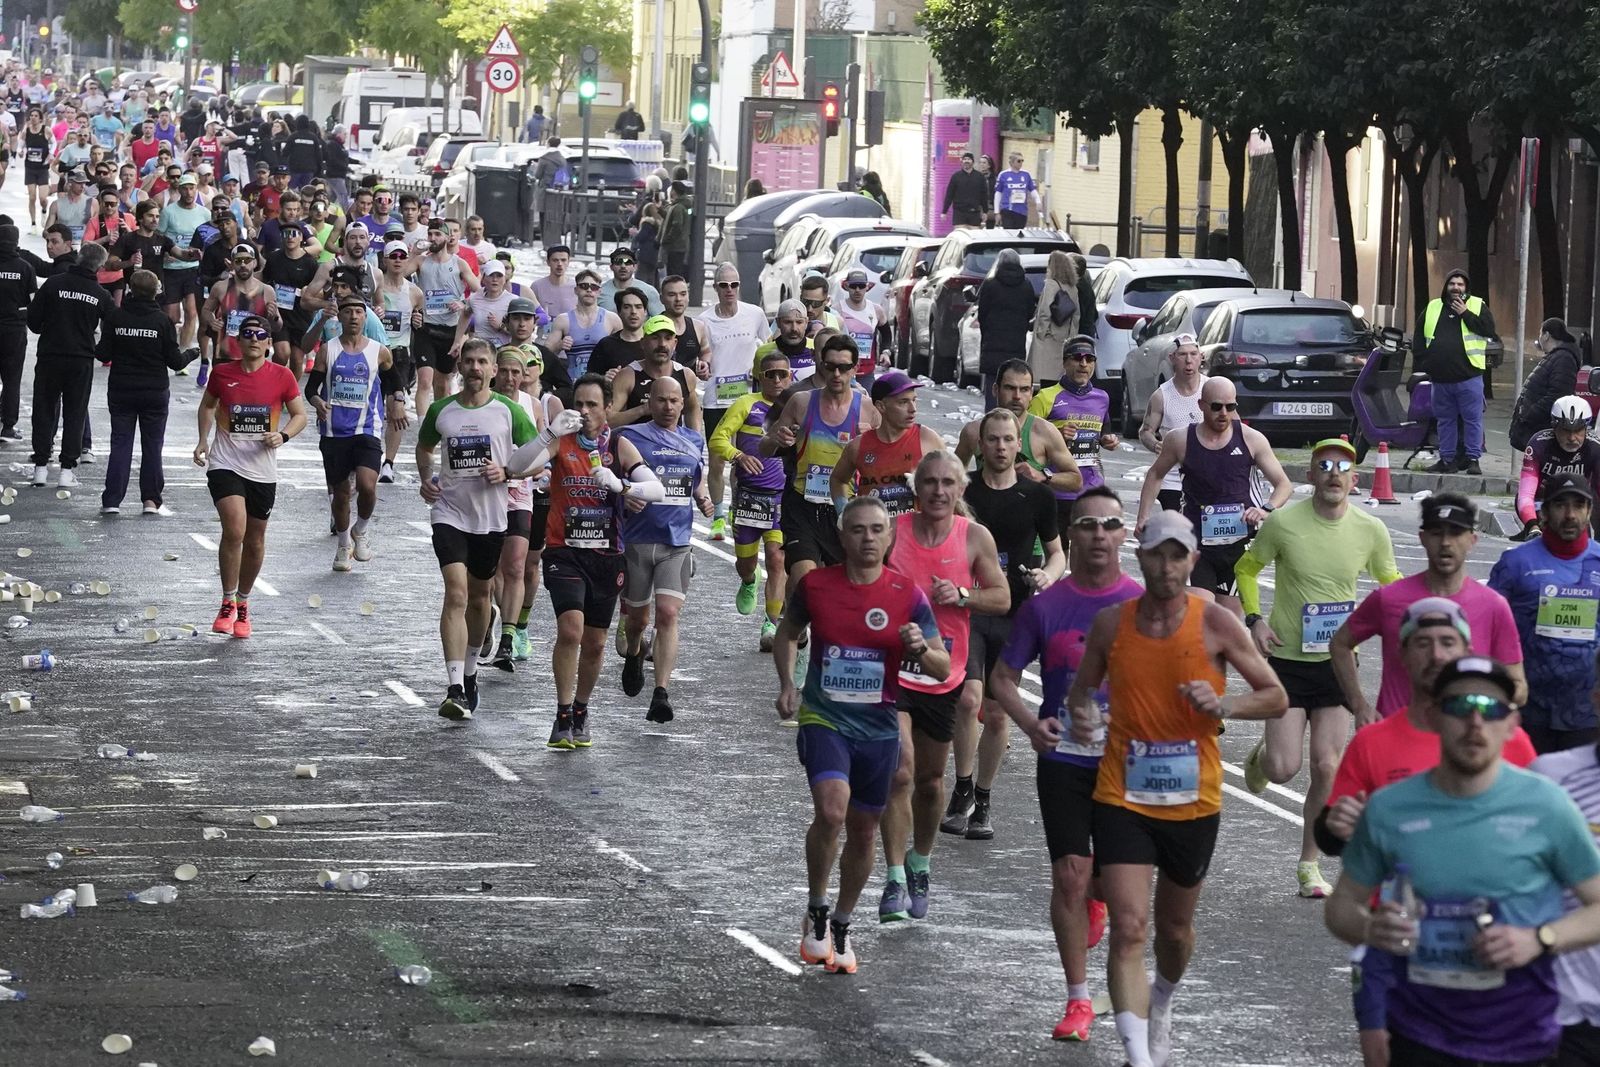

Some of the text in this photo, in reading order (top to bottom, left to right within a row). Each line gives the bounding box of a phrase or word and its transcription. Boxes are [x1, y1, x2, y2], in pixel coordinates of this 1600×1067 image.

[493, 69, 513, 81] 30
[58, 290, 99, 306] VOLUNTEER
[115, 327, 158, 338] VOLUNTEER
[334, 391, 364, 401] IBRAHIMI
[1281, 403, 1332, 415] 4249 GBR
[234, 424, 266, 432] SAMUEL
[461, 437, 486, 445] ZURICH
[454, 457, 487, 468] THOMAS
[1542, 463, 1554, 475] EL
[569, 487, 608, 501] CAMAS
[882, 486, 908, 496] ZURICH
[1217, 504, 1241, 513] ZURICH
[736, 509, 767, 520] EDUARDO
[571, 529, 605, 539] JUANCA
[1213, 525, 1236, 536] BRAD
[1560, 588, 1593, 598] ZURICH
[1322, 619, 1338, 628] 6093
[1555, 614, 1581, 627] DANI
[845, 650, 879, 660] ZURICH
[823, 674, 881, 691] BARREIRO
[1149, 744, 1188, 757] ZURICH
[1142, 774, 1181, 790] JORDI
